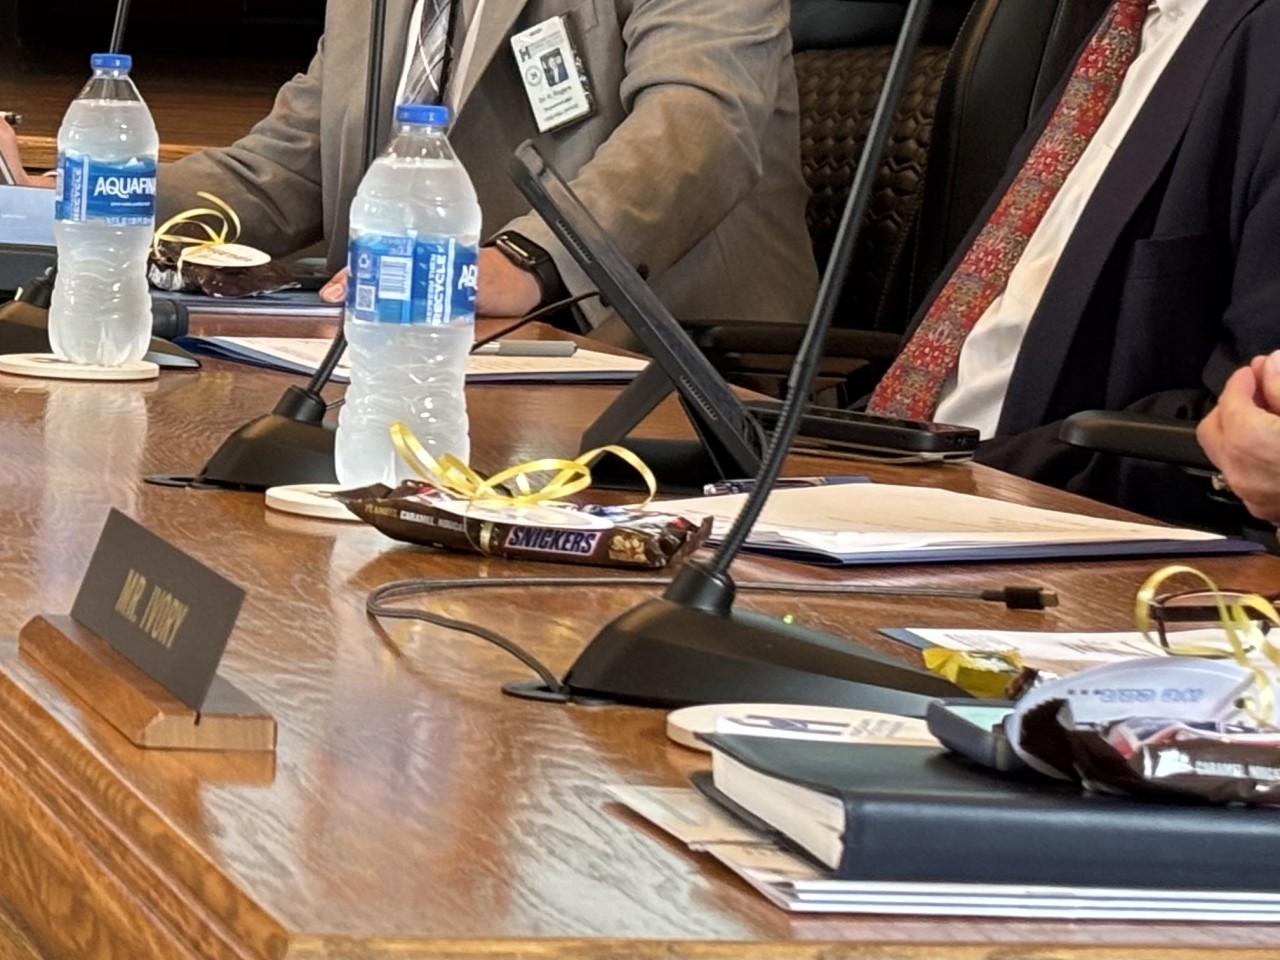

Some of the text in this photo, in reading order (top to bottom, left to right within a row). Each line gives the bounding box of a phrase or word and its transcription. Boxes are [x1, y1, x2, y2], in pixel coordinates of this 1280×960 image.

[433, 254, 447, 326] RECYCLE
[508, 526, 597, 555] SNICKERS
[114, 568, 189, 650] MR. IVORY
